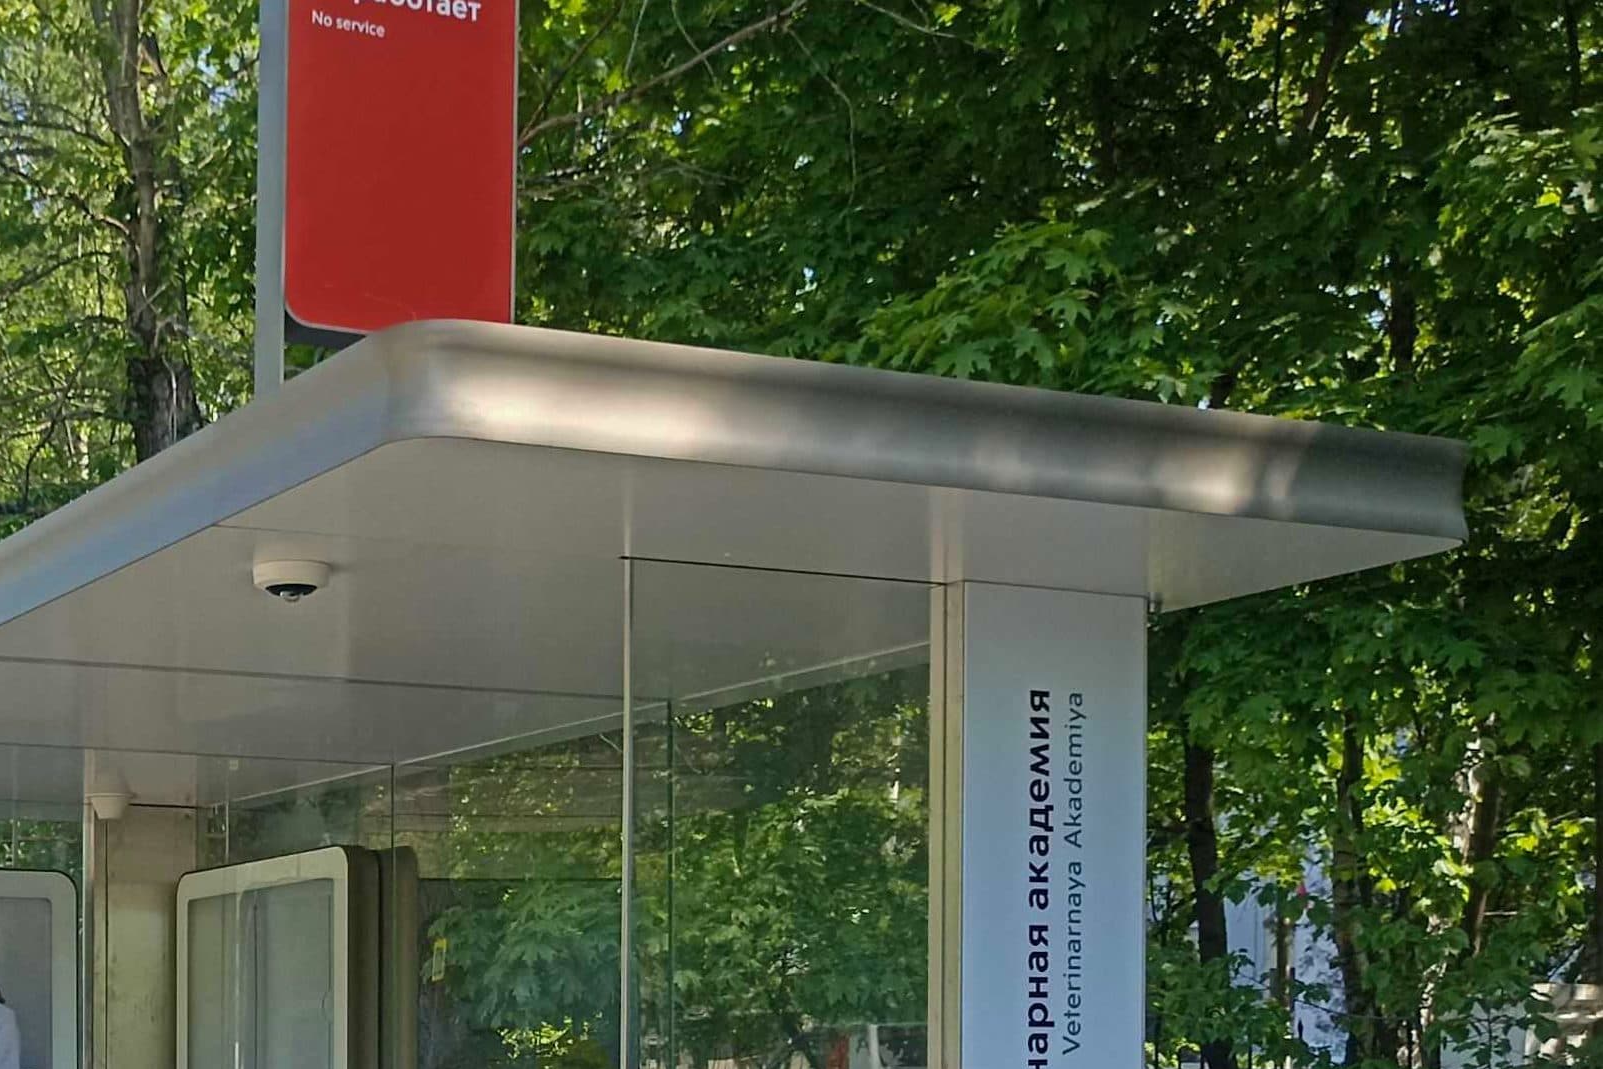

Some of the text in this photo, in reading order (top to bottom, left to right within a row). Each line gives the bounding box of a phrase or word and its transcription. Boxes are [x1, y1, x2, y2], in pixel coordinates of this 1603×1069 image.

[311, 9, 386, 38] No service
[353, 0, 481, 22] отает
[1027, 689, 1054, 910] академия
[1062, 691, 1087, 1055] Veterinarnaya Akademiya
